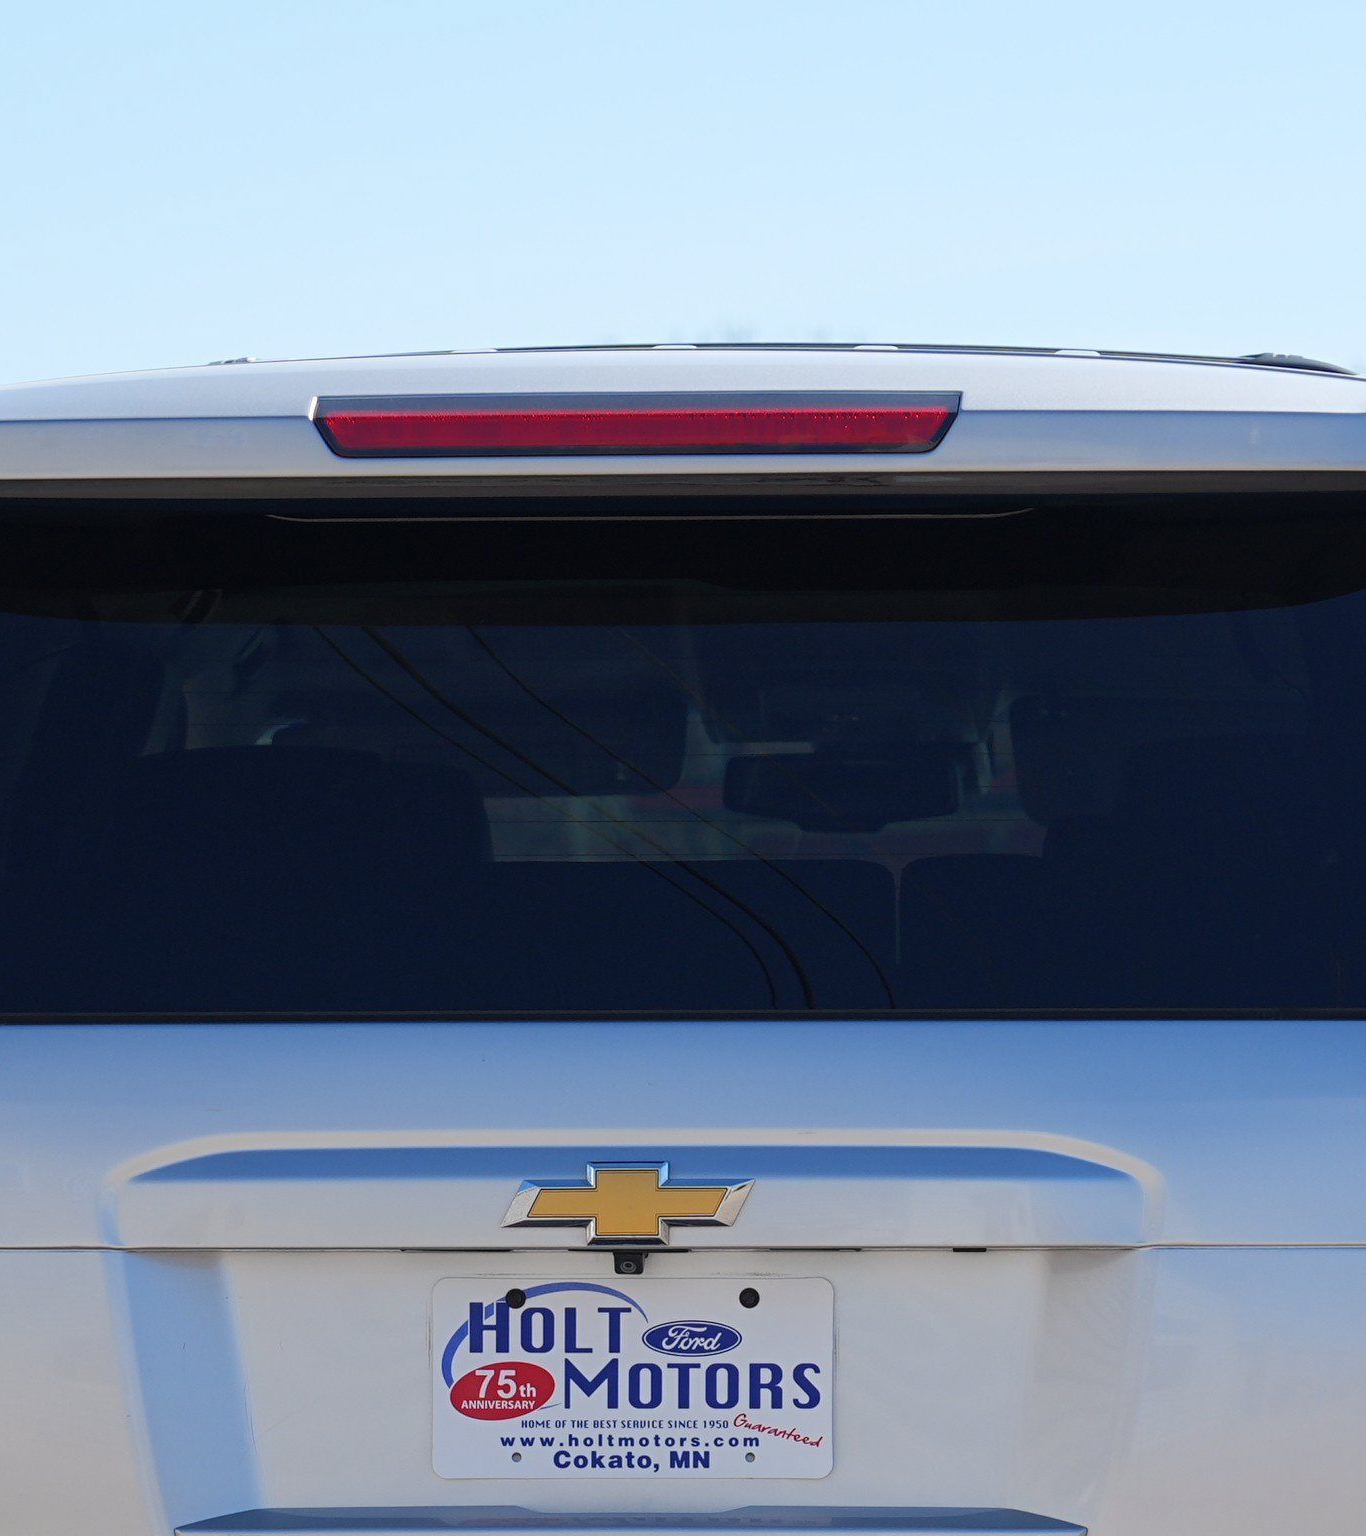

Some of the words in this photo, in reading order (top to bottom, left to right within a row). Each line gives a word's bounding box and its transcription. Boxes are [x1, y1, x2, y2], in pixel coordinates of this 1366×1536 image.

[469, 1301, 632, 1354] HOLT
[661, 1325, 723, 1351] Ford
[475, 1369, 537, 1400] 75th
[564, 1357, 821, 1410] MOTORS
[461, 1400, 536, 1411] ANNIVERSARY
[521, 1419, 551, 1430] HOME
[555, 1419, 567, 1430] OF
[570, 1419, 589, 1430] THE
[593, 1419, 618, 1430] BEST
[621, 1419, 665, 1430] SERVICE
[667, 1419, 699, 1430] SINCE
[703, 1419, 729, 1430] 1950
[733, 1413, 823, 1448] Guaranteed
[500, 1434, 760, 1447] www.holtmotors.com
[553, 1450, 660, 1473] Cokato,
[669, 1450, 711, 1469] MN
